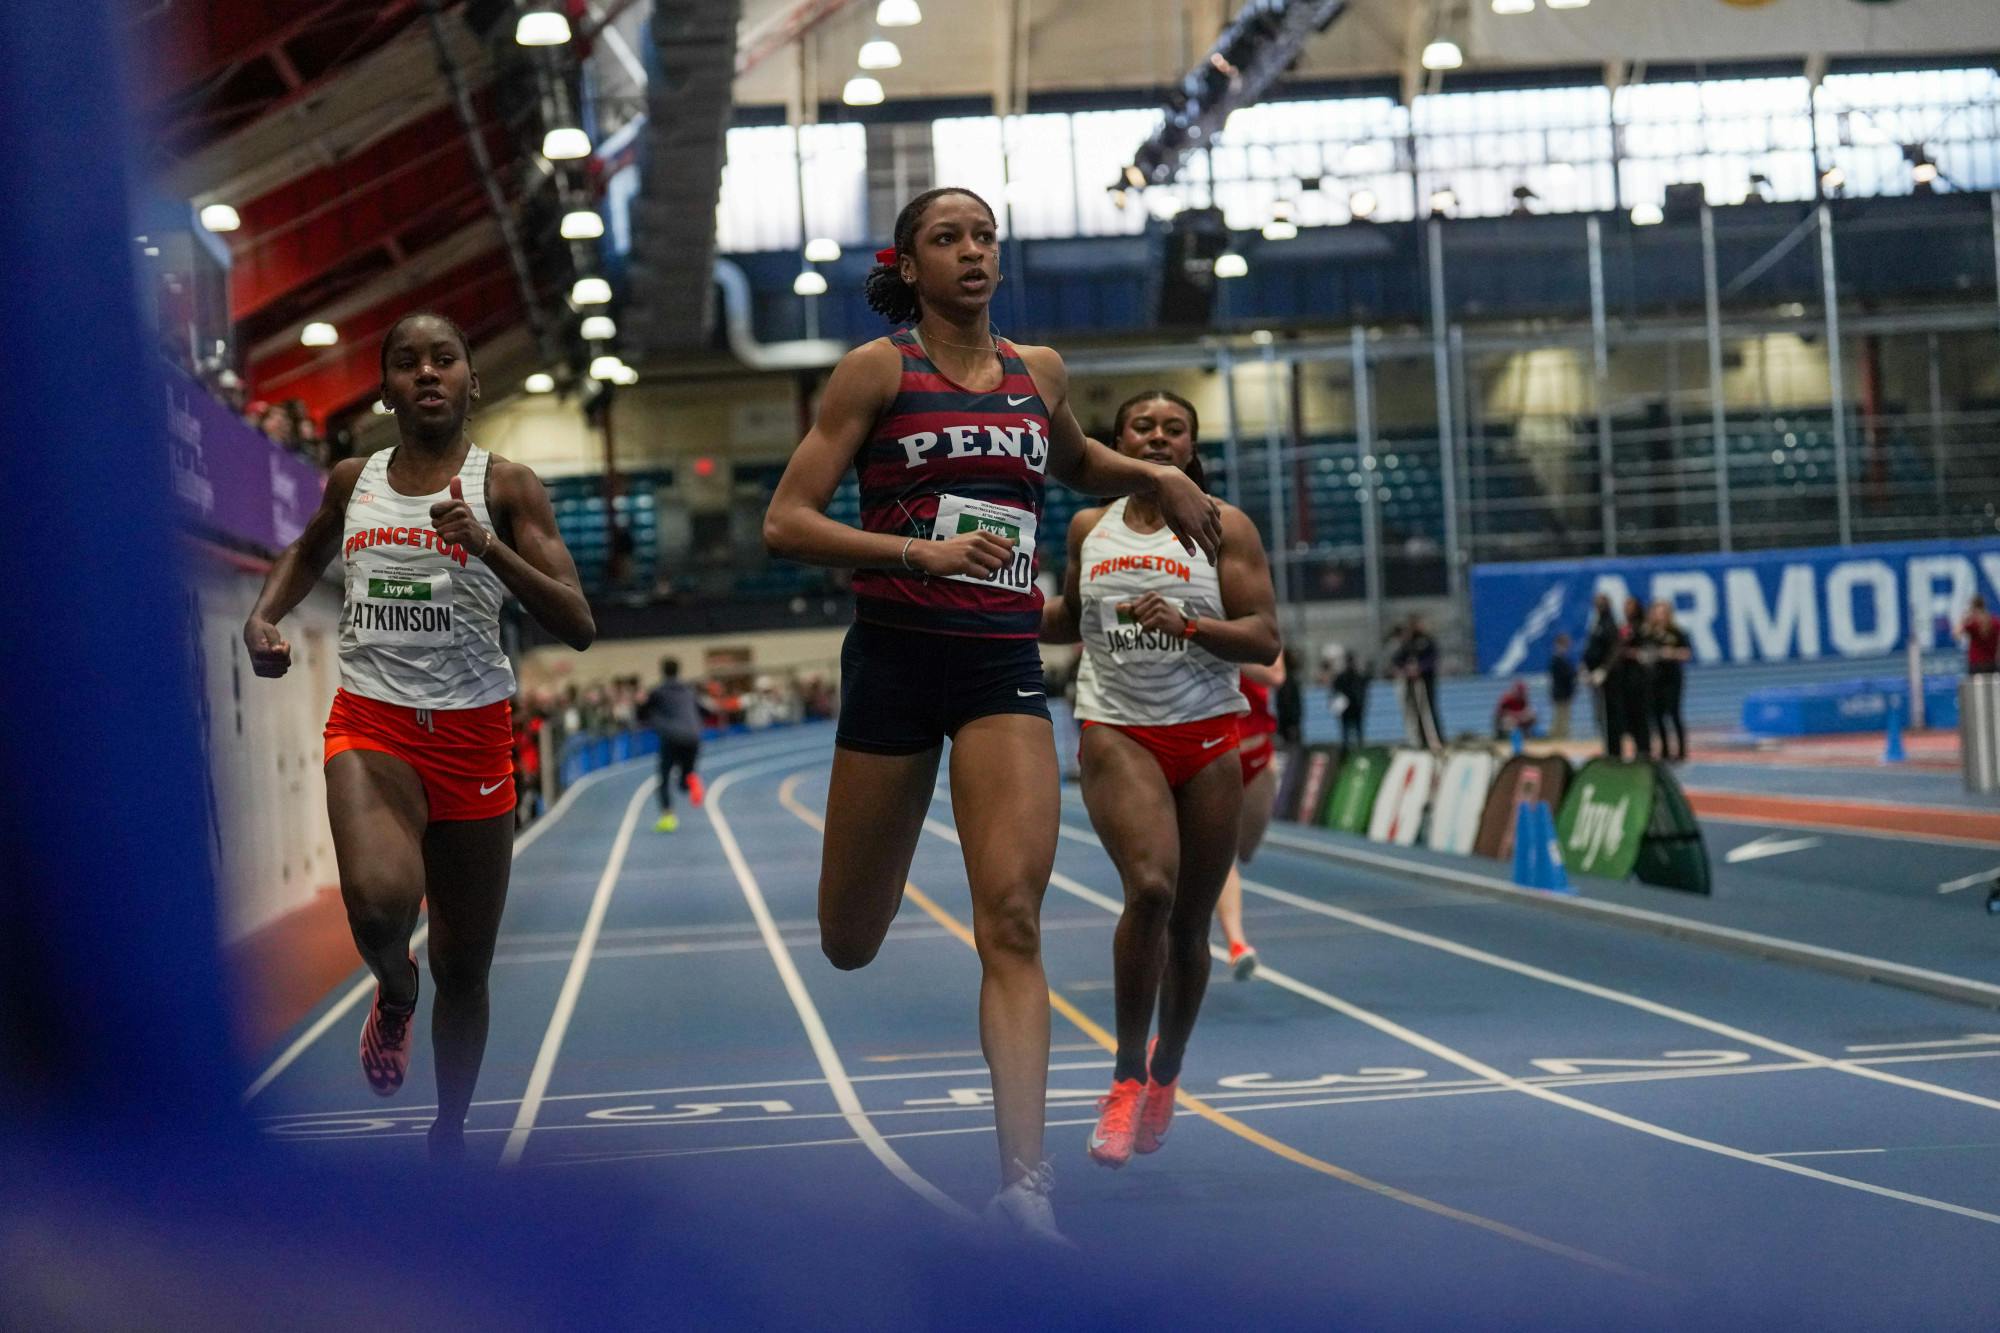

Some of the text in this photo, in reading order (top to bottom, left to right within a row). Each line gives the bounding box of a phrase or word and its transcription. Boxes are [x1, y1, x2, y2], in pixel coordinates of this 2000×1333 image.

[345, 527, 467, 568] PRINCETON
[1090, 555, 1190, 582] PRINCETON
[383, 582, 403, 597] Ivy
[352, 602, 451, 632] ATKINSON
[1107, 626, 1185, 653] JACKSON
